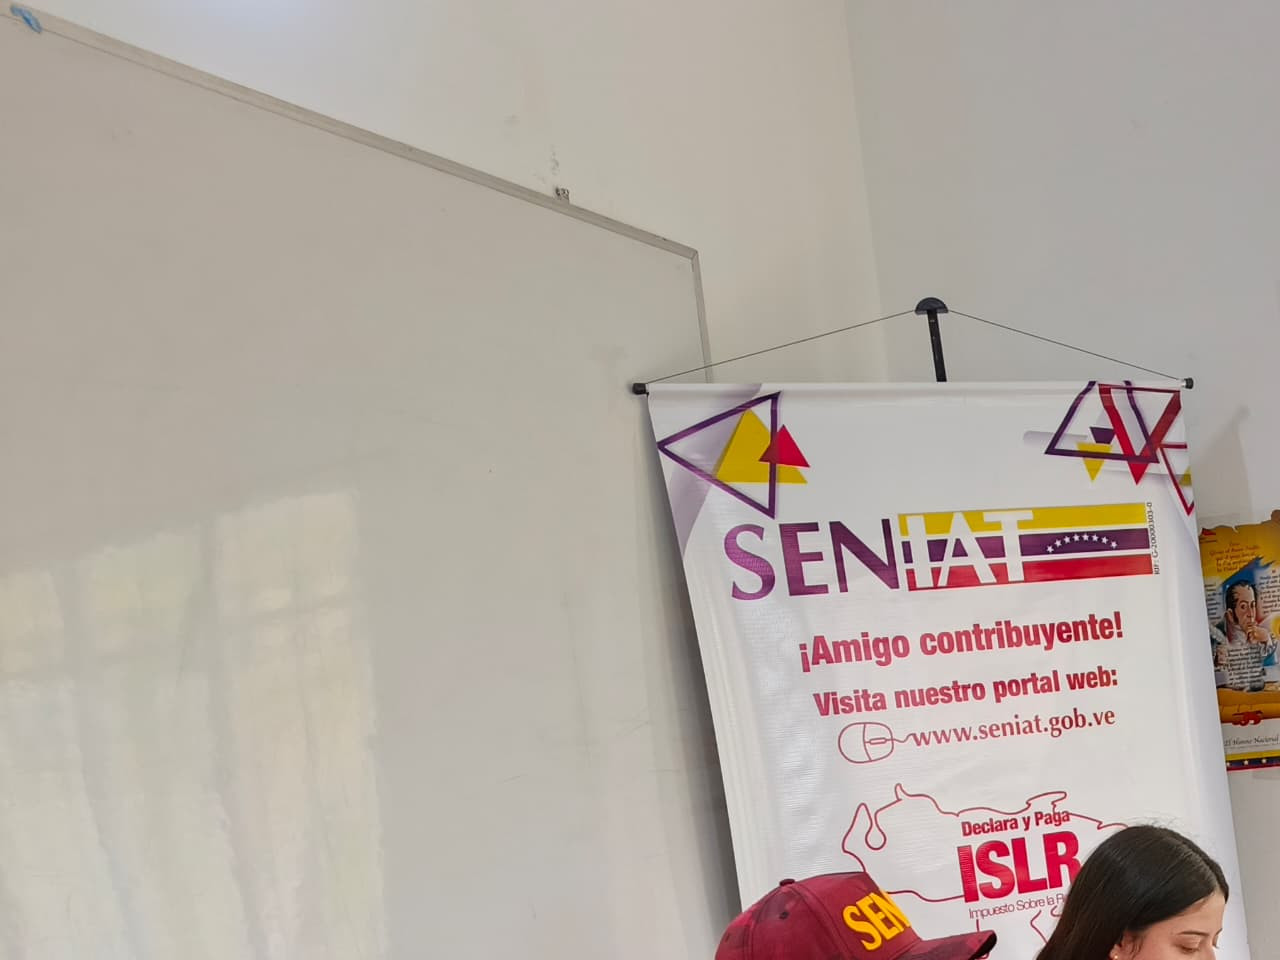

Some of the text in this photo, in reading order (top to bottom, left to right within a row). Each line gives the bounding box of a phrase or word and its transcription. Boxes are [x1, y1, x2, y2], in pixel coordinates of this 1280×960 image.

[723, 510, 1033, 601] SENIAT
[799, 611, 1124, 673] ¡Amigo contribuyente!
[813, 666, 1118, 717] Visita nuestro portal web:
[911, 707, 1117, 747] www.seniat.gob.ve
[961, 810, 1071, 837] Declara y Paga
[957, 830, 1082, 903] ISLR
[968, 903, 1015, 920] Impuesto
[1016, 895, 1046, 911] Sobre
[1046, 895, 1055, 906] la
